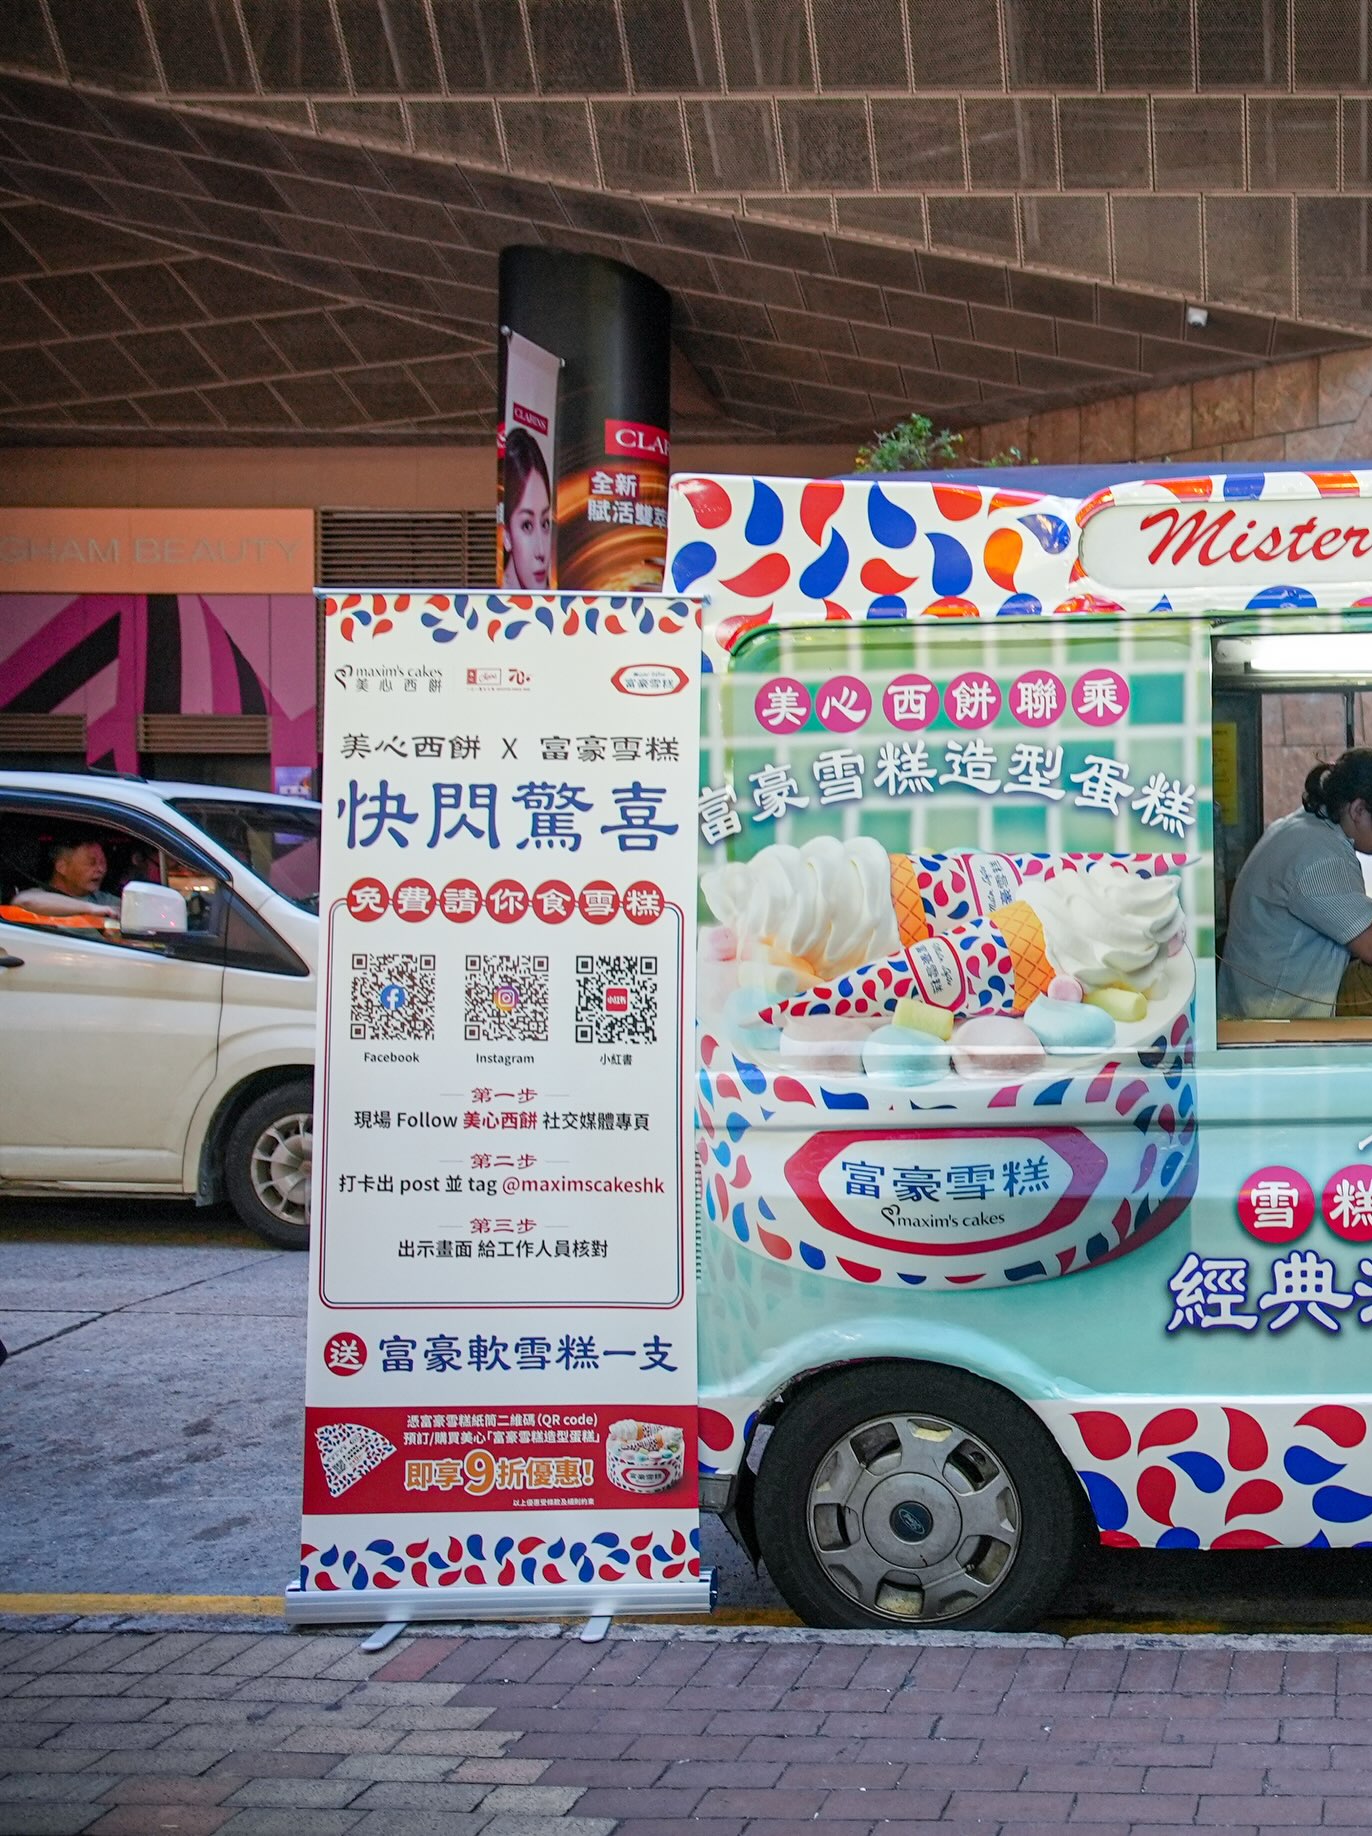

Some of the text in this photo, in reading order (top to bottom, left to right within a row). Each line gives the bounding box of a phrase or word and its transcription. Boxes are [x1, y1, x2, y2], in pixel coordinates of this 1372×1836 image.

[591, 471, 637, 497] 全新
[1140, 507, 1372, 567] Mister
[134, 538, 299, 563] BEAUTY
[356, 665, 442, 677] maxim's cakes
[356, 678, 442, 692] 美心西餅
[760, 678, 1125, 728] 美心西餅聯乘
[341, 733, 680, 761] 美心西餅 X 富豪雪糕
[698, 738, 1196, 844] 富豪雪糕造型蛋糕
[337, 779, 679, 852] 快閃驚喜
[351, 886, 661, 916] 免費請你食雪糕
[364, 1051, 420, 1063] Facebook
[475, 1053, 535, 1066] Instagram
[600, 1053, 633, 1066] 小紅書
[471, 1087, 538, 1103] 第一步
[354, 1111, 650, 1130] 現場 Follow 美心西餅 社交媒體專頁
[470, 1153, 537, 1170] 第二步
[339, 1174, 664, 1196] 打卡出 post 並 tag @maximscakeshk
[841, 1156, 1051, 1204] 富豪雪糕
[470, 1218, 537, 1234] 第三步
[898, 1210, 1006, 1228] maxim's cakes
[398, 1240, 609, 1259] 出示畫面 給工作人員核對
[330, 1339, 363, 1369] 送
[379, 1334, 678, 1372] 富豪軟雪糕一支
[538, 1414, 561, 1427] (QR
[563, 1414, 598, 1427] code)
